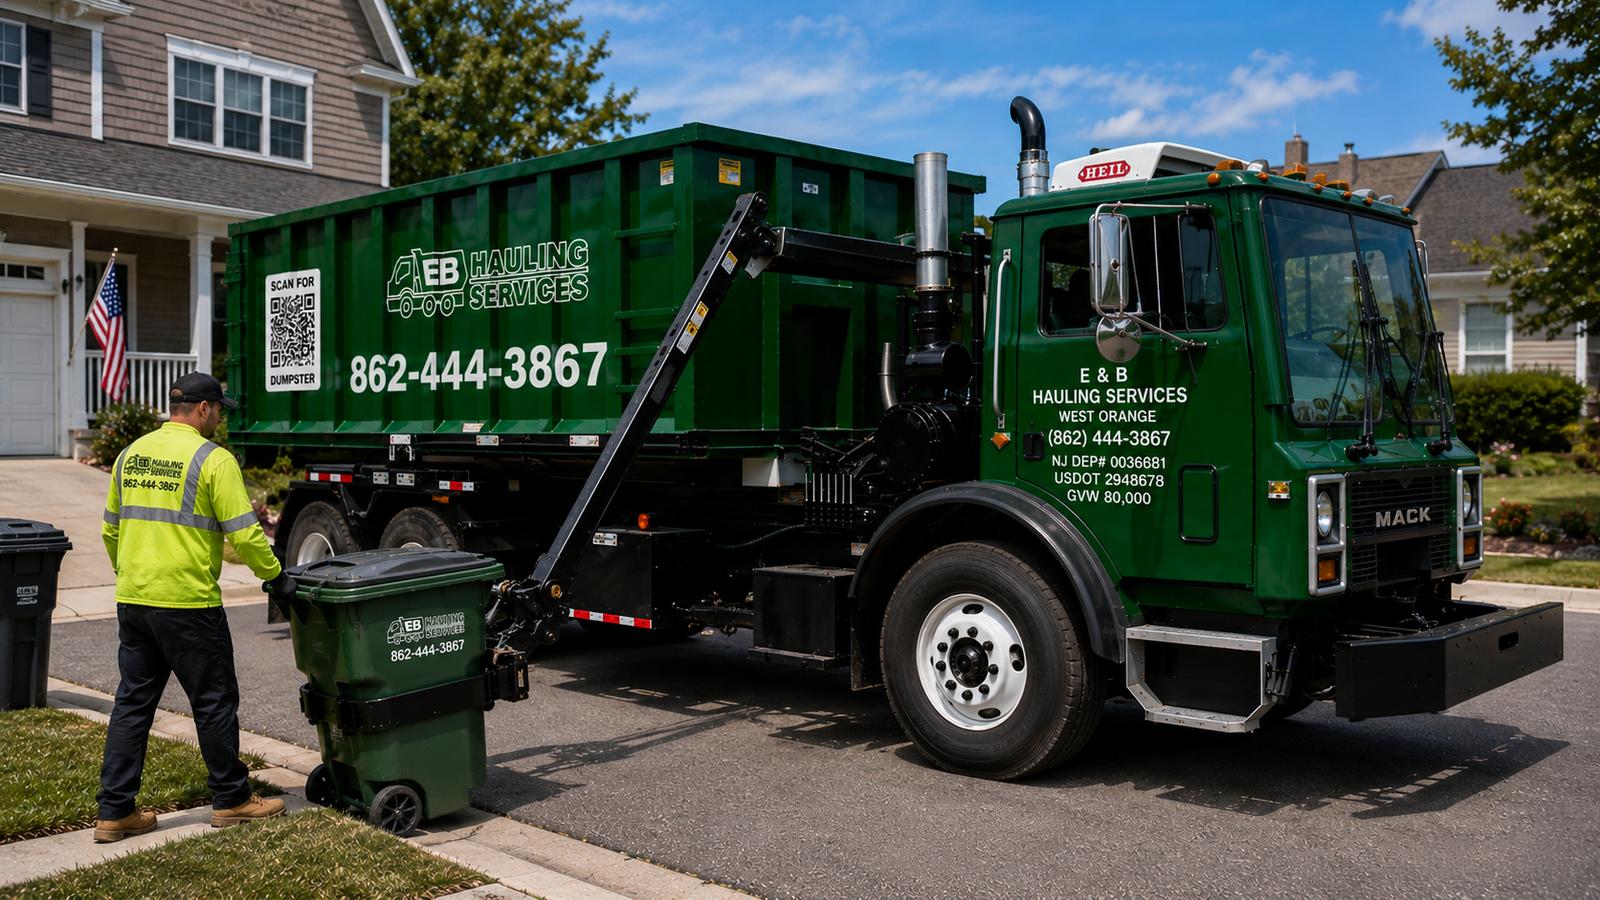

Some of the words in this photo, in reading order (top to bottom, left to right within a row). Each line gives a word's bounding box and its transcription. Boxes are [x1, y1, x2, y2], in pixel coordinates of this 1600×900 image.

[1085, 163, 1126, 179] HEIL
[470, 239, 589, 277] HAULING
[422, 257, 459, 286] EB
[271, 278, 294, 291] SCAN
[296, 276, 315, 289] FOR
[469, 273, 589, 310] SERVICES
[350, 342, 608, 393] 862-444-3867
[1080, 368, 1090, 383] E
[1097, 367, 1109, 383] &
[1116, 366, 1128, 383] B
[270, 373, 315, 386] DUMPSTER
[1033, 389, 1101, 404] HAULING
[1106, 387, 1187, 403] SERVICES
[1059, 410, 1095, 422] WEST
[1098, 410, 1156, 423] ORANGE
[1048, 429, 1087, 447] (862)
[1092, 430, 1171, 446] 444-3867
[1052, 455, 1067, 467] NJ
[1072, 455, 1106, 468] DEP#
[1110, 456, 1166, 469] 0036681
[123, 478, 180, 492] 862-444-3867
[1054, 472, 1100, 485] USDOT
[1105, 473, 1164, 487] 2948678
[1067, 489, 1100, 502] GVW
[1104, 491, 1151, 505] 80,000
[1376, 507, 1431, 528] MACK
[404, 620, 422, 632] EB
[391, 640, 464, 662] 862-444-3867
